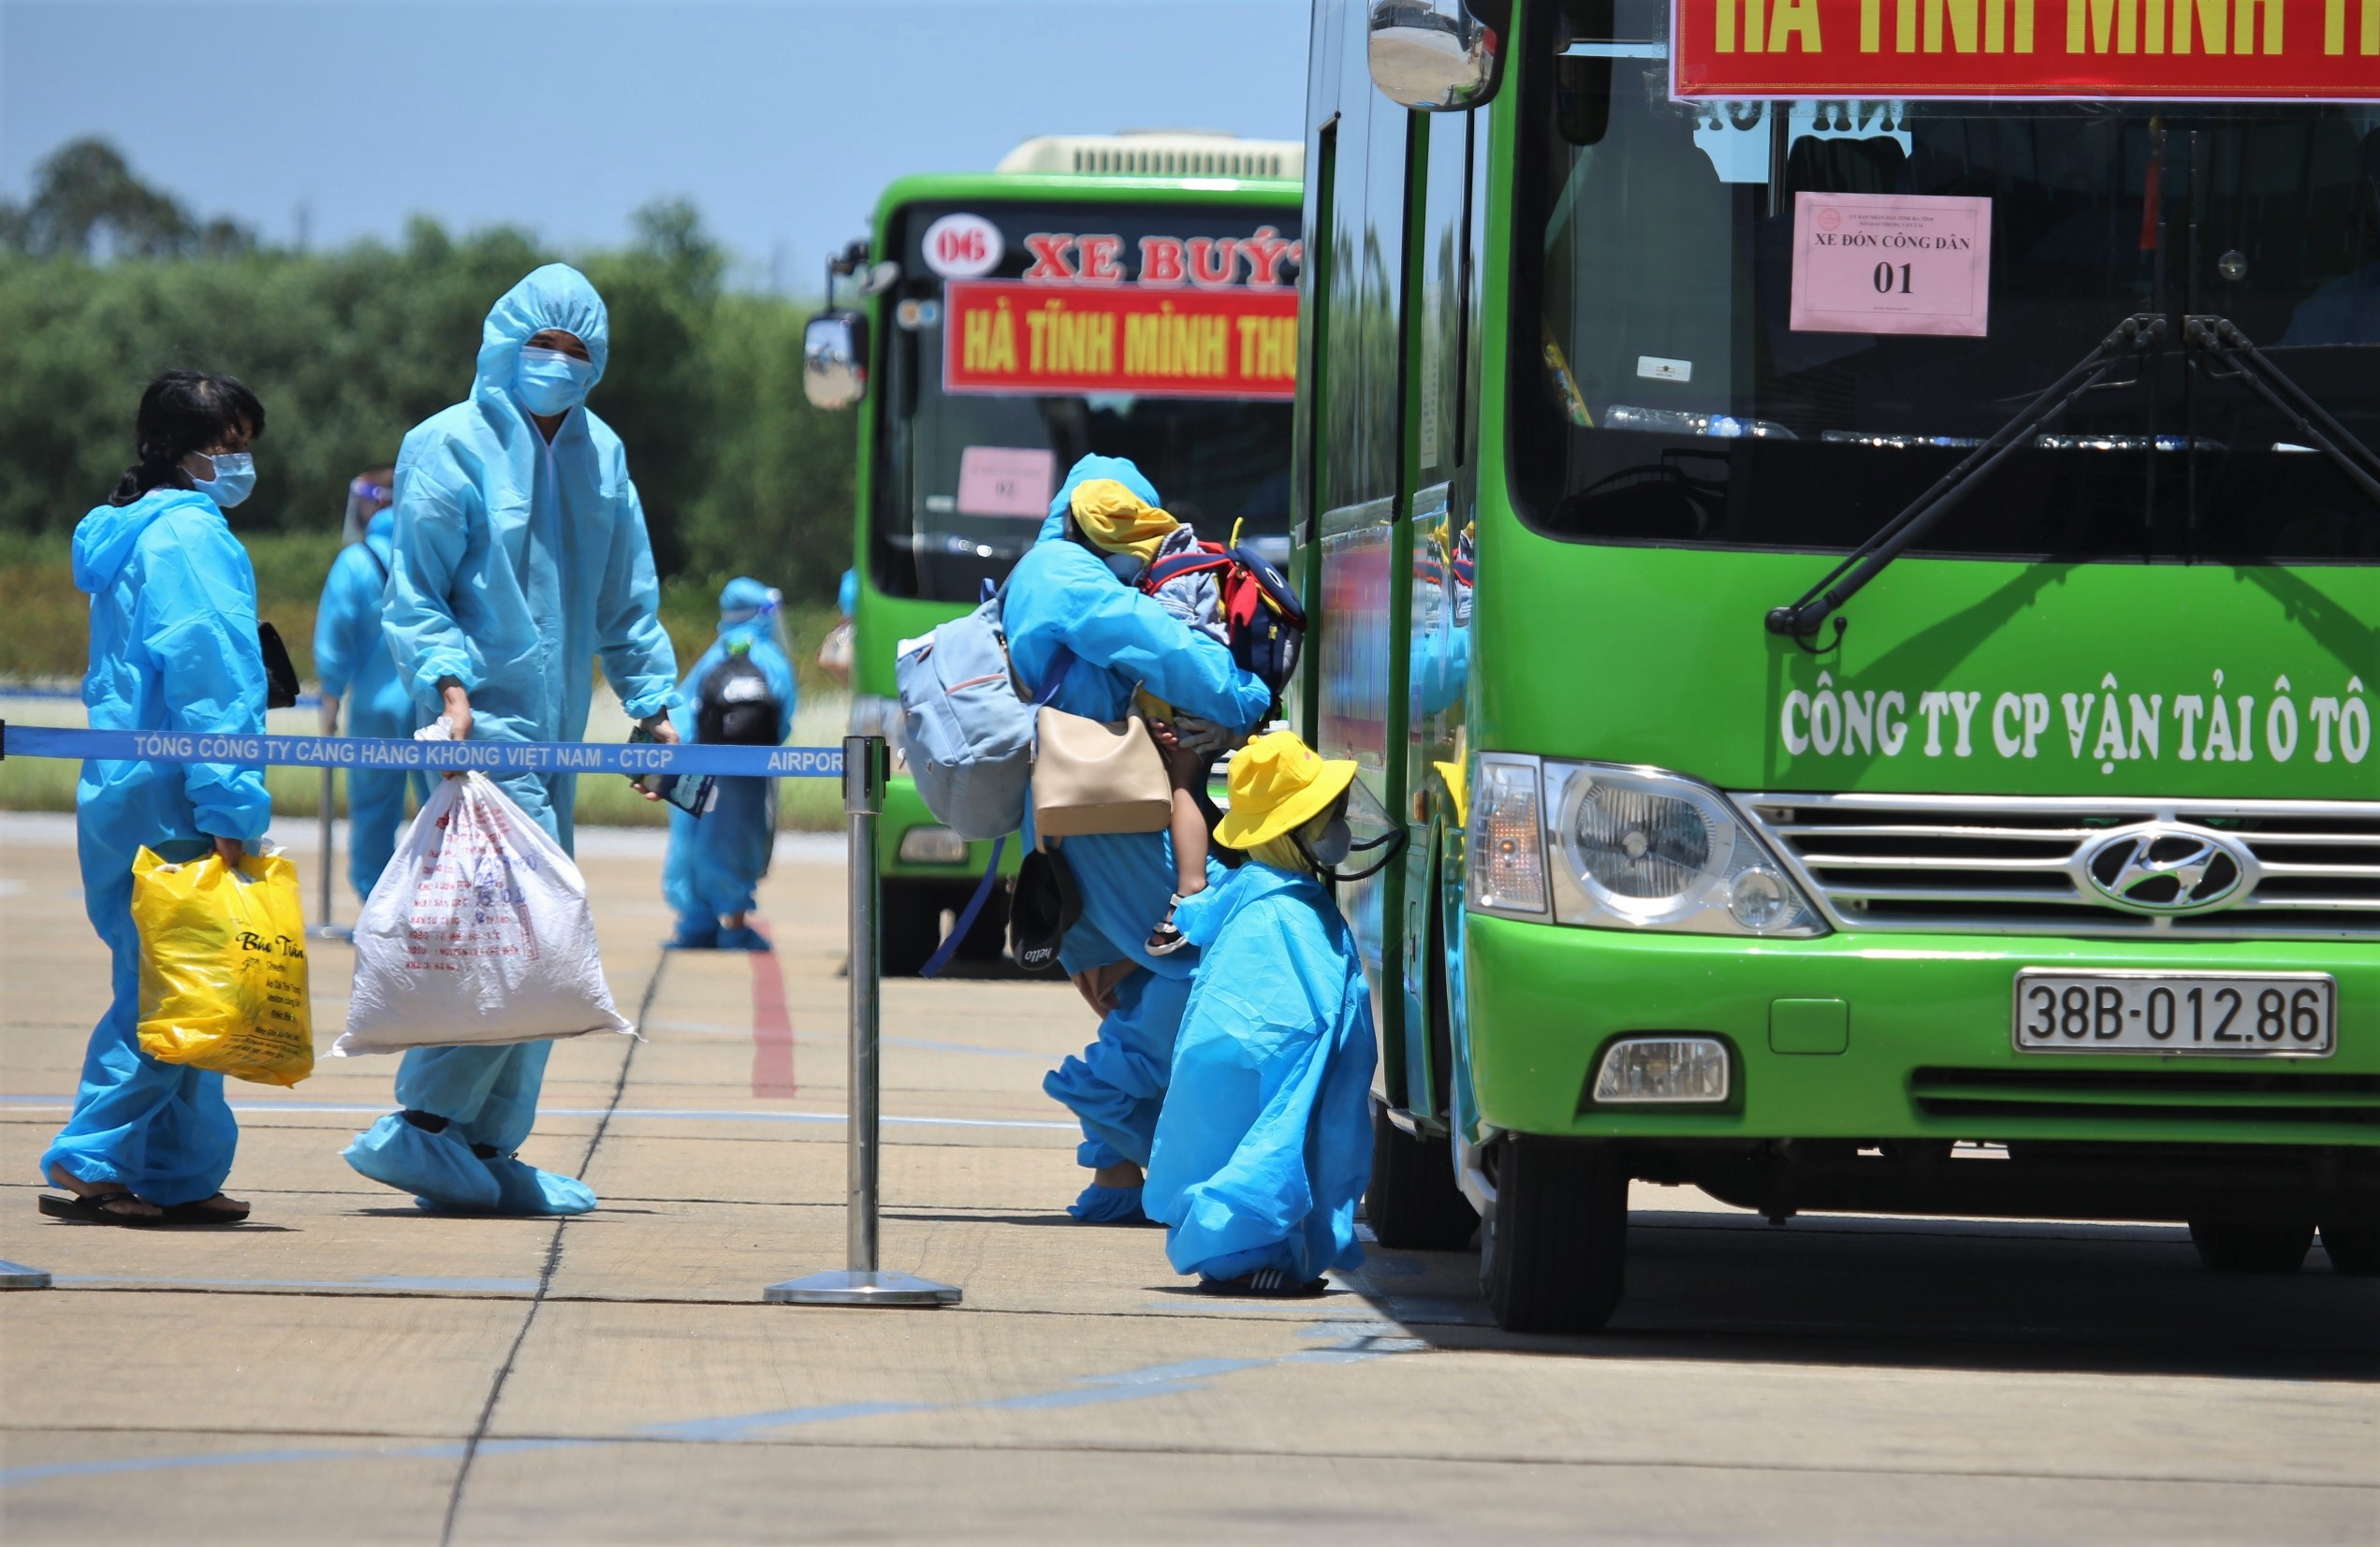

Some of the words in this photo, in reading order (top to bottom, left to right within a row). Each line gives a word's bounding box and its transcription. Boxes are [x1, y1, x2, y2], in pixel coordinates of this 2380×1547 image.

[937, 227, 986, 264] 06
[1024, 232, 1127, 286] XE
[1137, 224, 1303, 286] BUÝ
[1814, 232, 1837, 247] XE
[1841, 231, 1877, 248] ĐÓN
[1881, 232, 1931, 250] CÔNG
[1935, 233, 1972, 251] DÂN
[1873, 260, 1914, 295] 01
[963, 295, 1017, 372] HÀ
[1780, 669, 1908, 757] CÔNG
[1919, 690, 1982, 758] TY
[1991, 691, 2051, 759] CP
[2060, 671, 2164, 775] VẬN
[2172, 667, 2256, 762] TẢI
[2265, 673, 2300, 764] Ô
[2309, 674, 2373, 765] TÔ
[134, 732, 193, 757] TỔNG
[198, 734, 258, 760] CÔNG
[264, 739, 291, 760] TY
[296, 737, 355, 764] CẢNG
[360, 738, 420, 765] HÀNG
[425, 741, 500, 766] KHÔNG
[505, 744, 550, 770] VIỆT
[556, 748, 602, 768] NAM
[619, 749, 673, 769] CTCP
[1024, 947, 1052, 963] hello
[2027, 985, 2321, 1043] 38B-012.86
